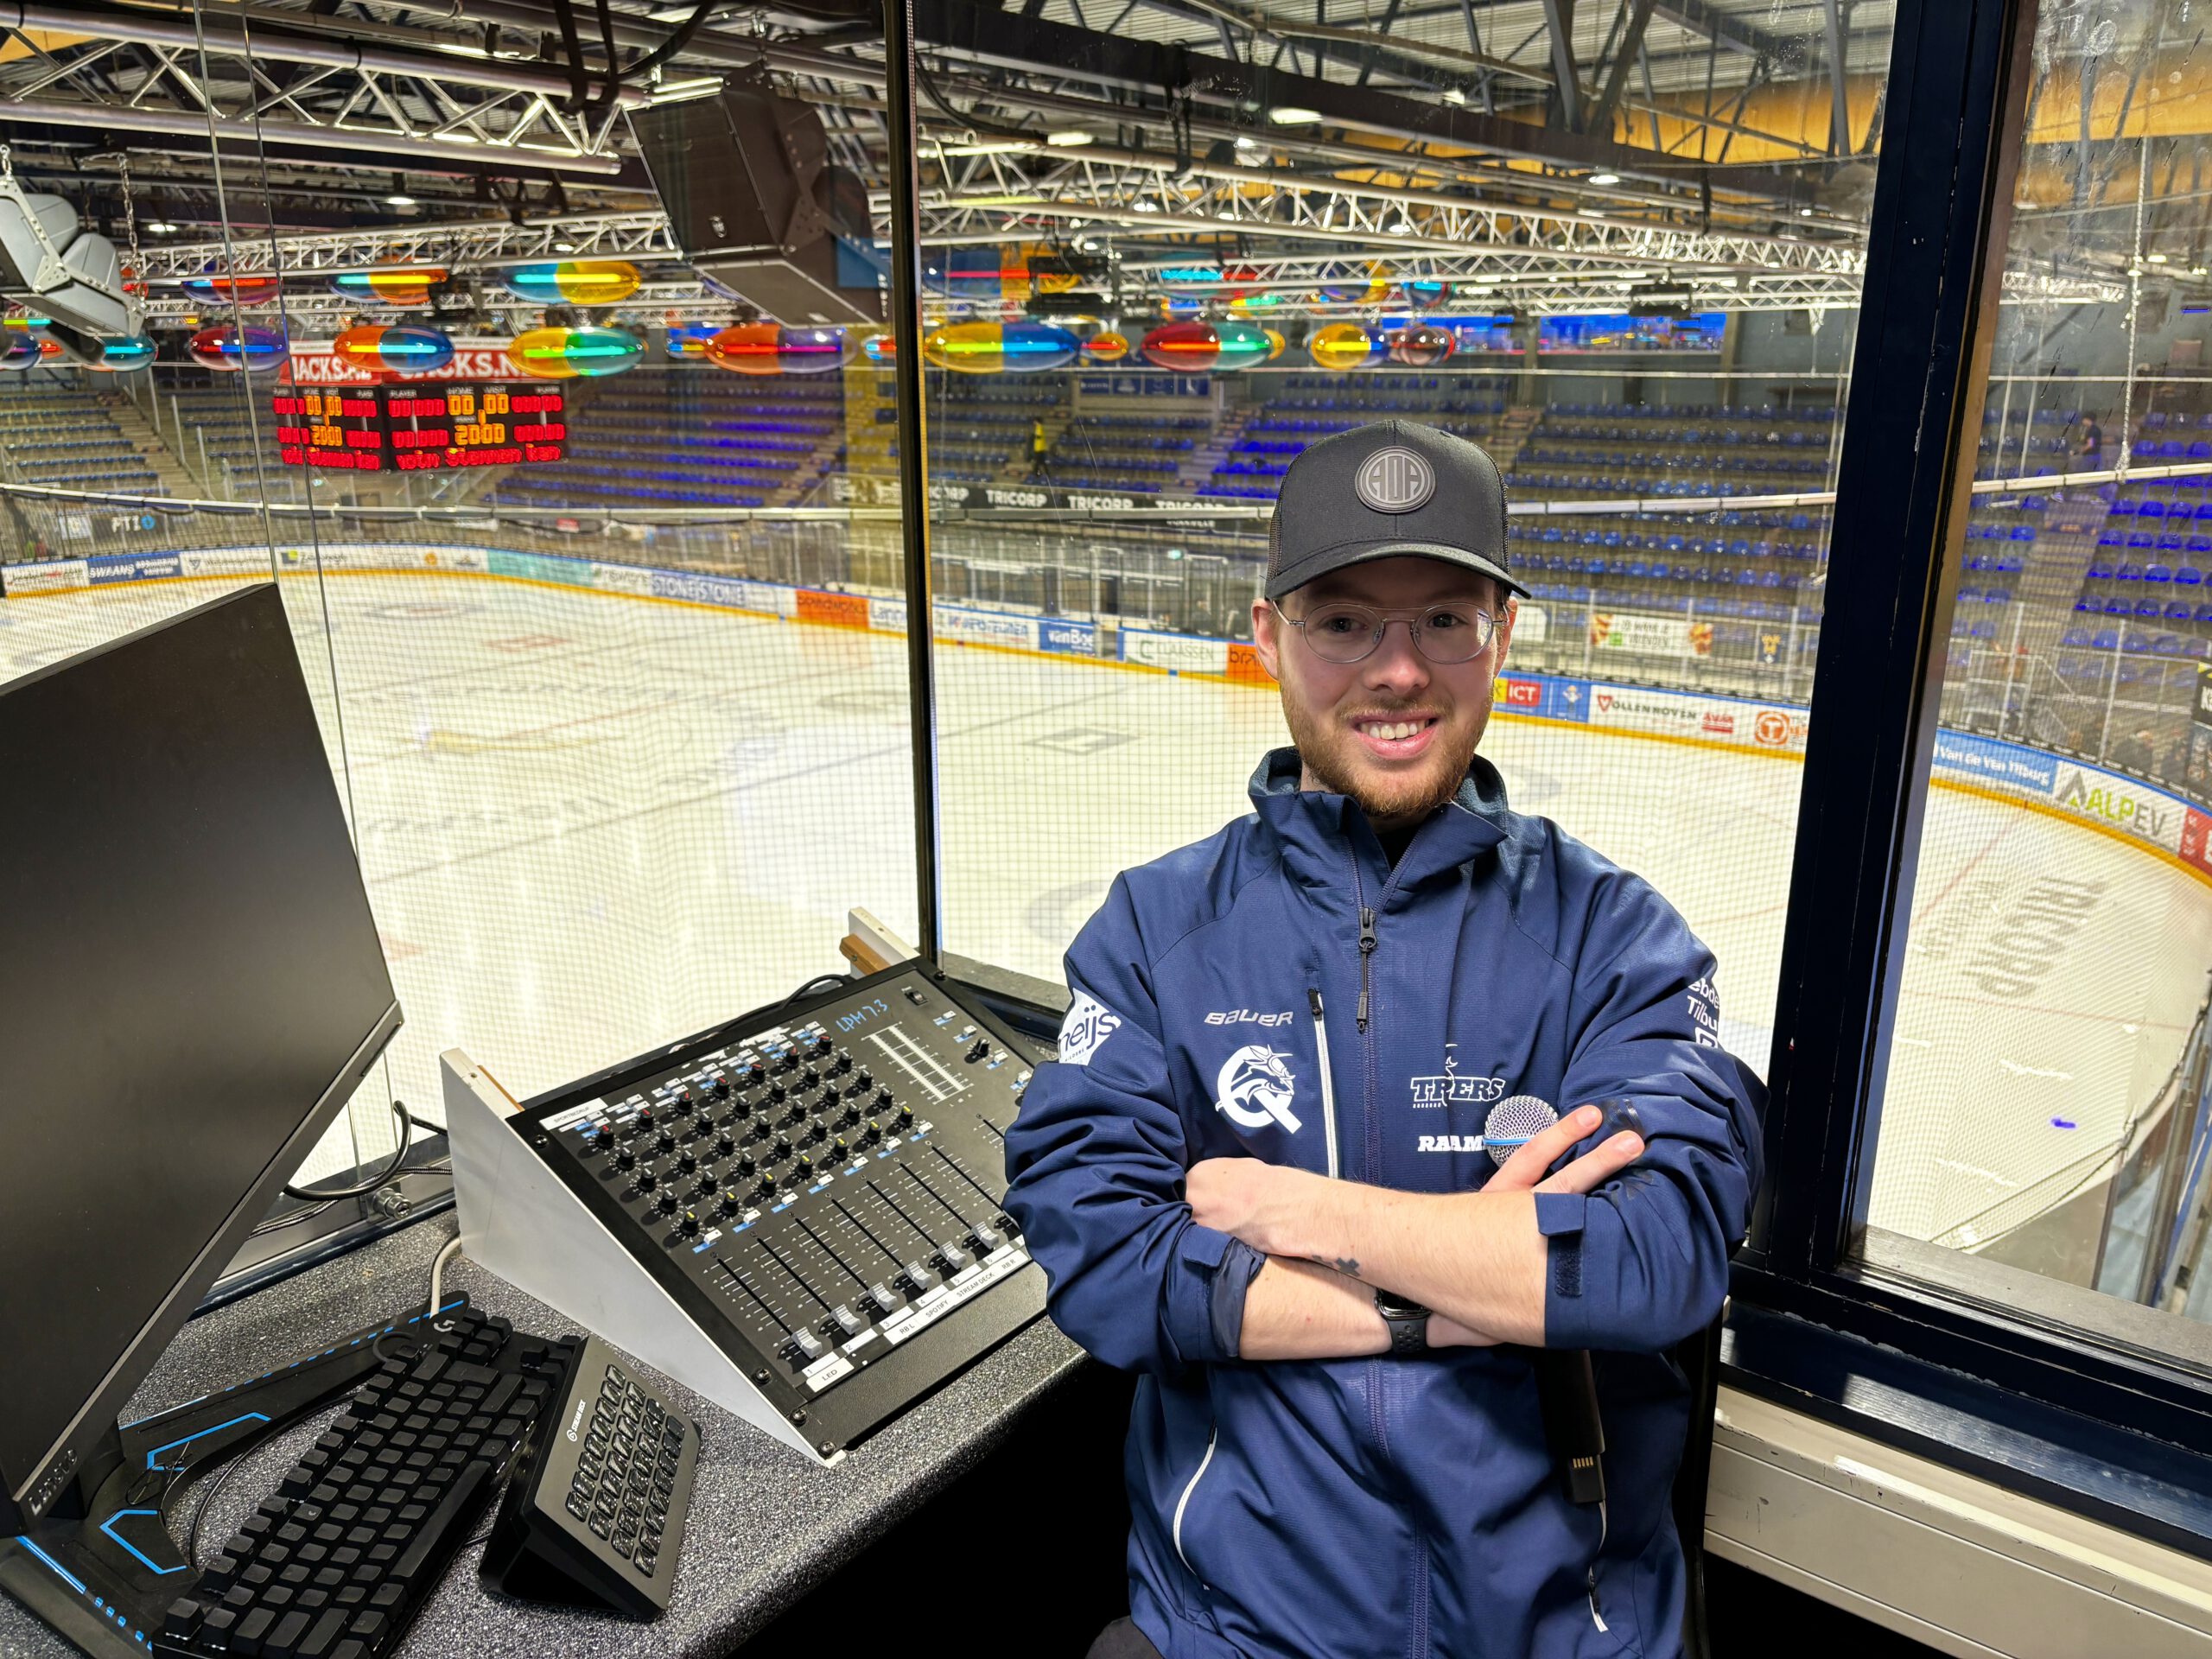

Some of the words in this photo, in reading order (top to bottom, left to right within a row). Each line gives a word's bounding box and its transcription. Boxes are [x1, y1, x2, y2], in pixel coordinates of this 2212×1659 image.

[448, 395, 475, 416] 00
[483, 394, 509, 415] 00
[986, 489, 1048, 508] TRICORP
[1067, 495, 1135, 510] TRICORP
[1509, 684, 1535, 702] ICT
[1940, 745, 1962, 762] Van
[1984, 755, 2006, 772] Ven
[1961, 876, 2110, 999] TRICORP
[957, 1281, 980, 1298] STREAM
[979, 1272, 995, 1286] DECK
[925, 1300, 949, 1318] SPOTIFY
[899, 1325, 910, 1335] RB
[822, 1369, 838, 1382] LED
